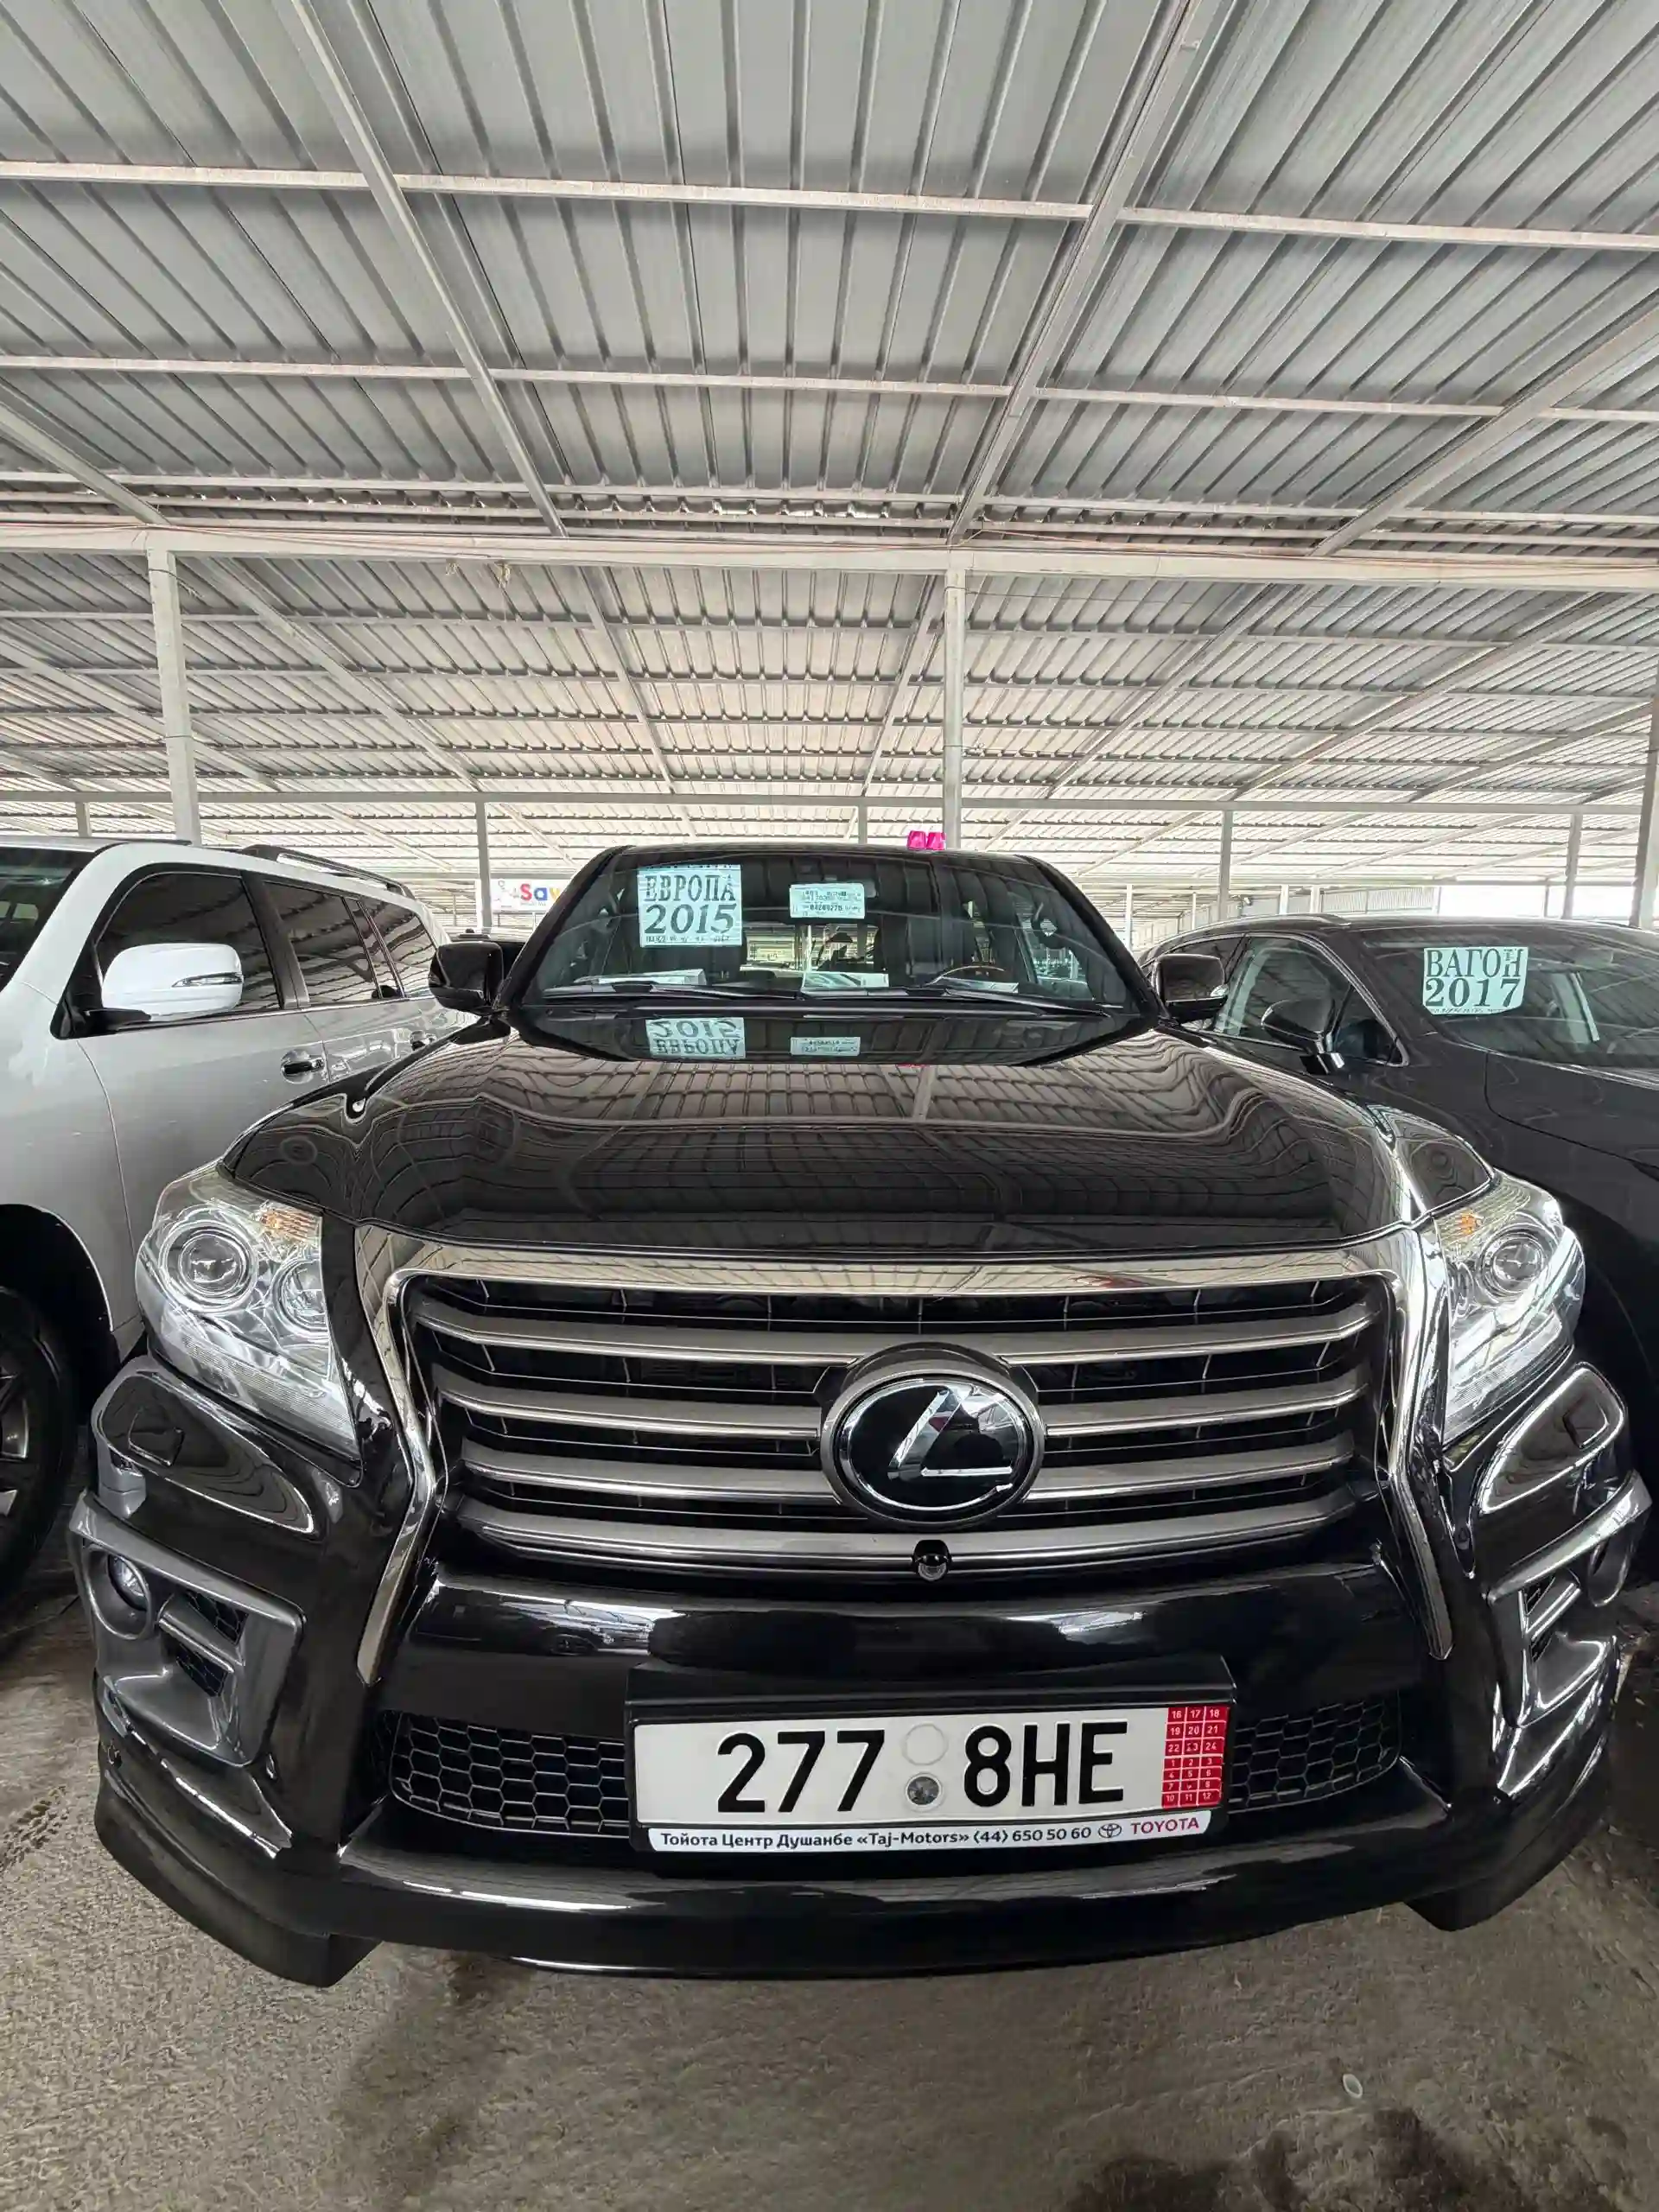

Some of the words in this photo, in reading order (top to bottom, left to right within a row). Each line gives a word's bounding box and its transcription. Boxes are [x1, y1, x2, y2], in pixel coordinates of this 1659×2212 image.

[644, 874, 736, 902] ЕВРОПА
[644, 903, 737, 934] 2015
[1427, 948, 1524, 977] ВАГОН
[1426, 977, 1521, 1007] 2017
[1171, 1710, 1182, 1719] 16
[1190, 1709, 1201, 1719] 17
[1209, 1708, 1220, 1718] 18
[1170, 1726, 1180, 1736] 19
[1188, 1726, 1200, 1735] 20
[1207, 1725, 1218, 1734] 21
[1167, 1744, 1179, 1753] 22
[1205, 1742, 1217, 1751] 24
[716, 1729, 886, 1814] 277
[660, 1832, 718, 1846] Тойота
[721, 1833, 774, 1849] Центр
[777, 1833, 853, 1849] Душанбе
[856, 1831, 969, 1847] «Taj-Motors»
[973, 1830, 1009, 1843] (44)
[1012, 1829, 1043, 1841] 650
[1046, 1828, 1067, 1840] 50
[1071, 1827, 1091, 1840] 60
[1130, 1816, 1200, 1835] TOYOTA
